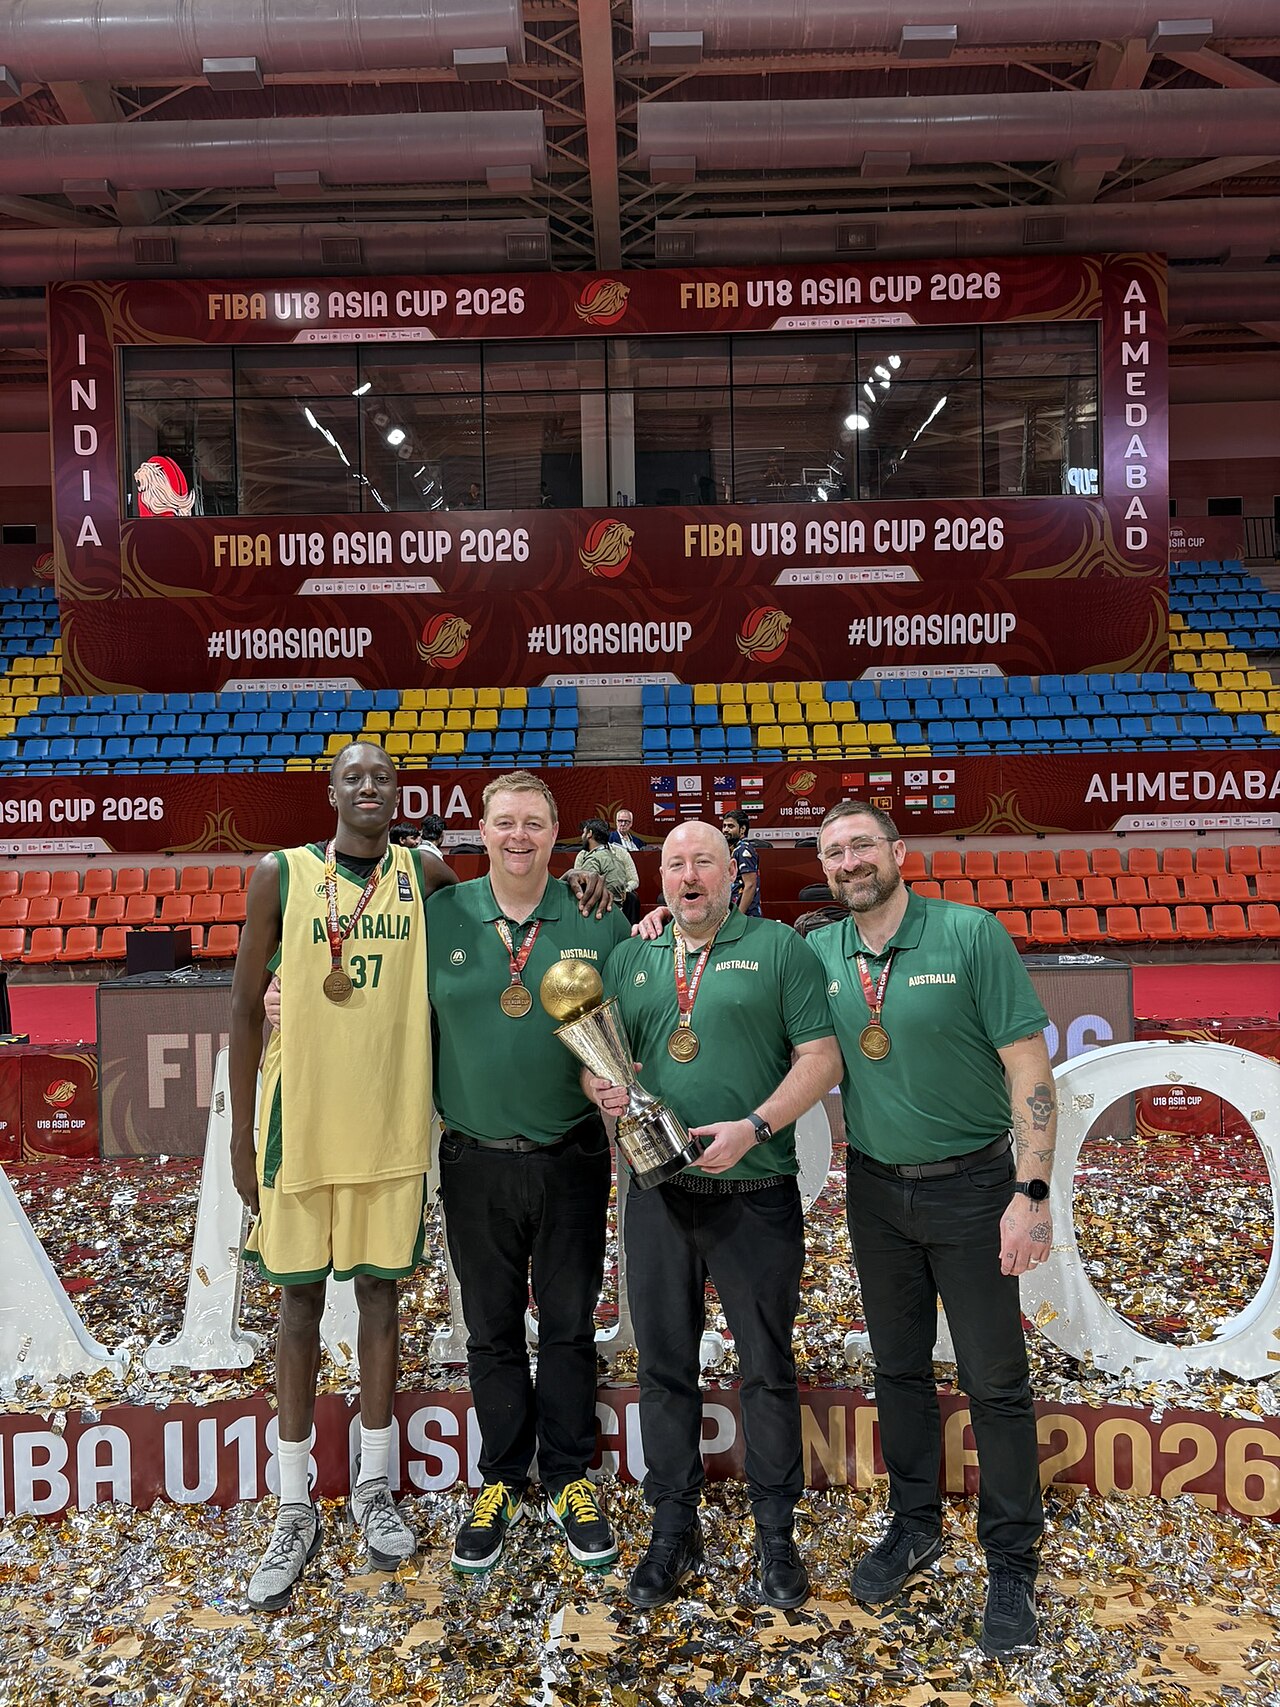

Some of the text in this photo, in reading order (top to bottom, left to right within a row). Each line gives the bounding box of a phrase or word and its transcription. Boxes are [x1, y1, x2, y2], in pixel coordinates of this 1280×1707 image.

[208, 287, 526, 320] FIBA U18 ASIA CUP 2026
[681, 272, 1001, 309] FIBA U18 ASIA CUP 2026
[1122, 280, 1149, 550] AHMEDABAD
[71, 334, 102, 546] INDIA
[213, 528, 531, 568] FIBA U18 ASIA CUP 2026
[685, 516, 1005, 558] FIBA U18 ASIA CUP 2026
[1188, 538, 1205, 547] CUP
[207, 627, 374, 662] #U18ASIACUP
[527, 620, 693, 656] #U18ASIACUP
[847, 612, 1018, 647] #U18ASIACUP
[0, 796, 164, 824] SIA CUP 2026
[780, 806, 826, 816] U18 ASIA CUP
[357, 896, 367, 908] CUP
[350, 954, 383, 989] 37
[560, 949, 598, 961] AUSTRALIA
[715, 960, 759, 972] AUSTRALIA
[908, 973, 957, 987] AUSTRALIA
[1153, 1096, 1202, 1106] U18 ASIA CUP
[37, 1120, 86, 1129] U18 ASIA CUP
[0, 1424, 132, 1516] BA
[1036, 1413, 1280, 1517] 2026
